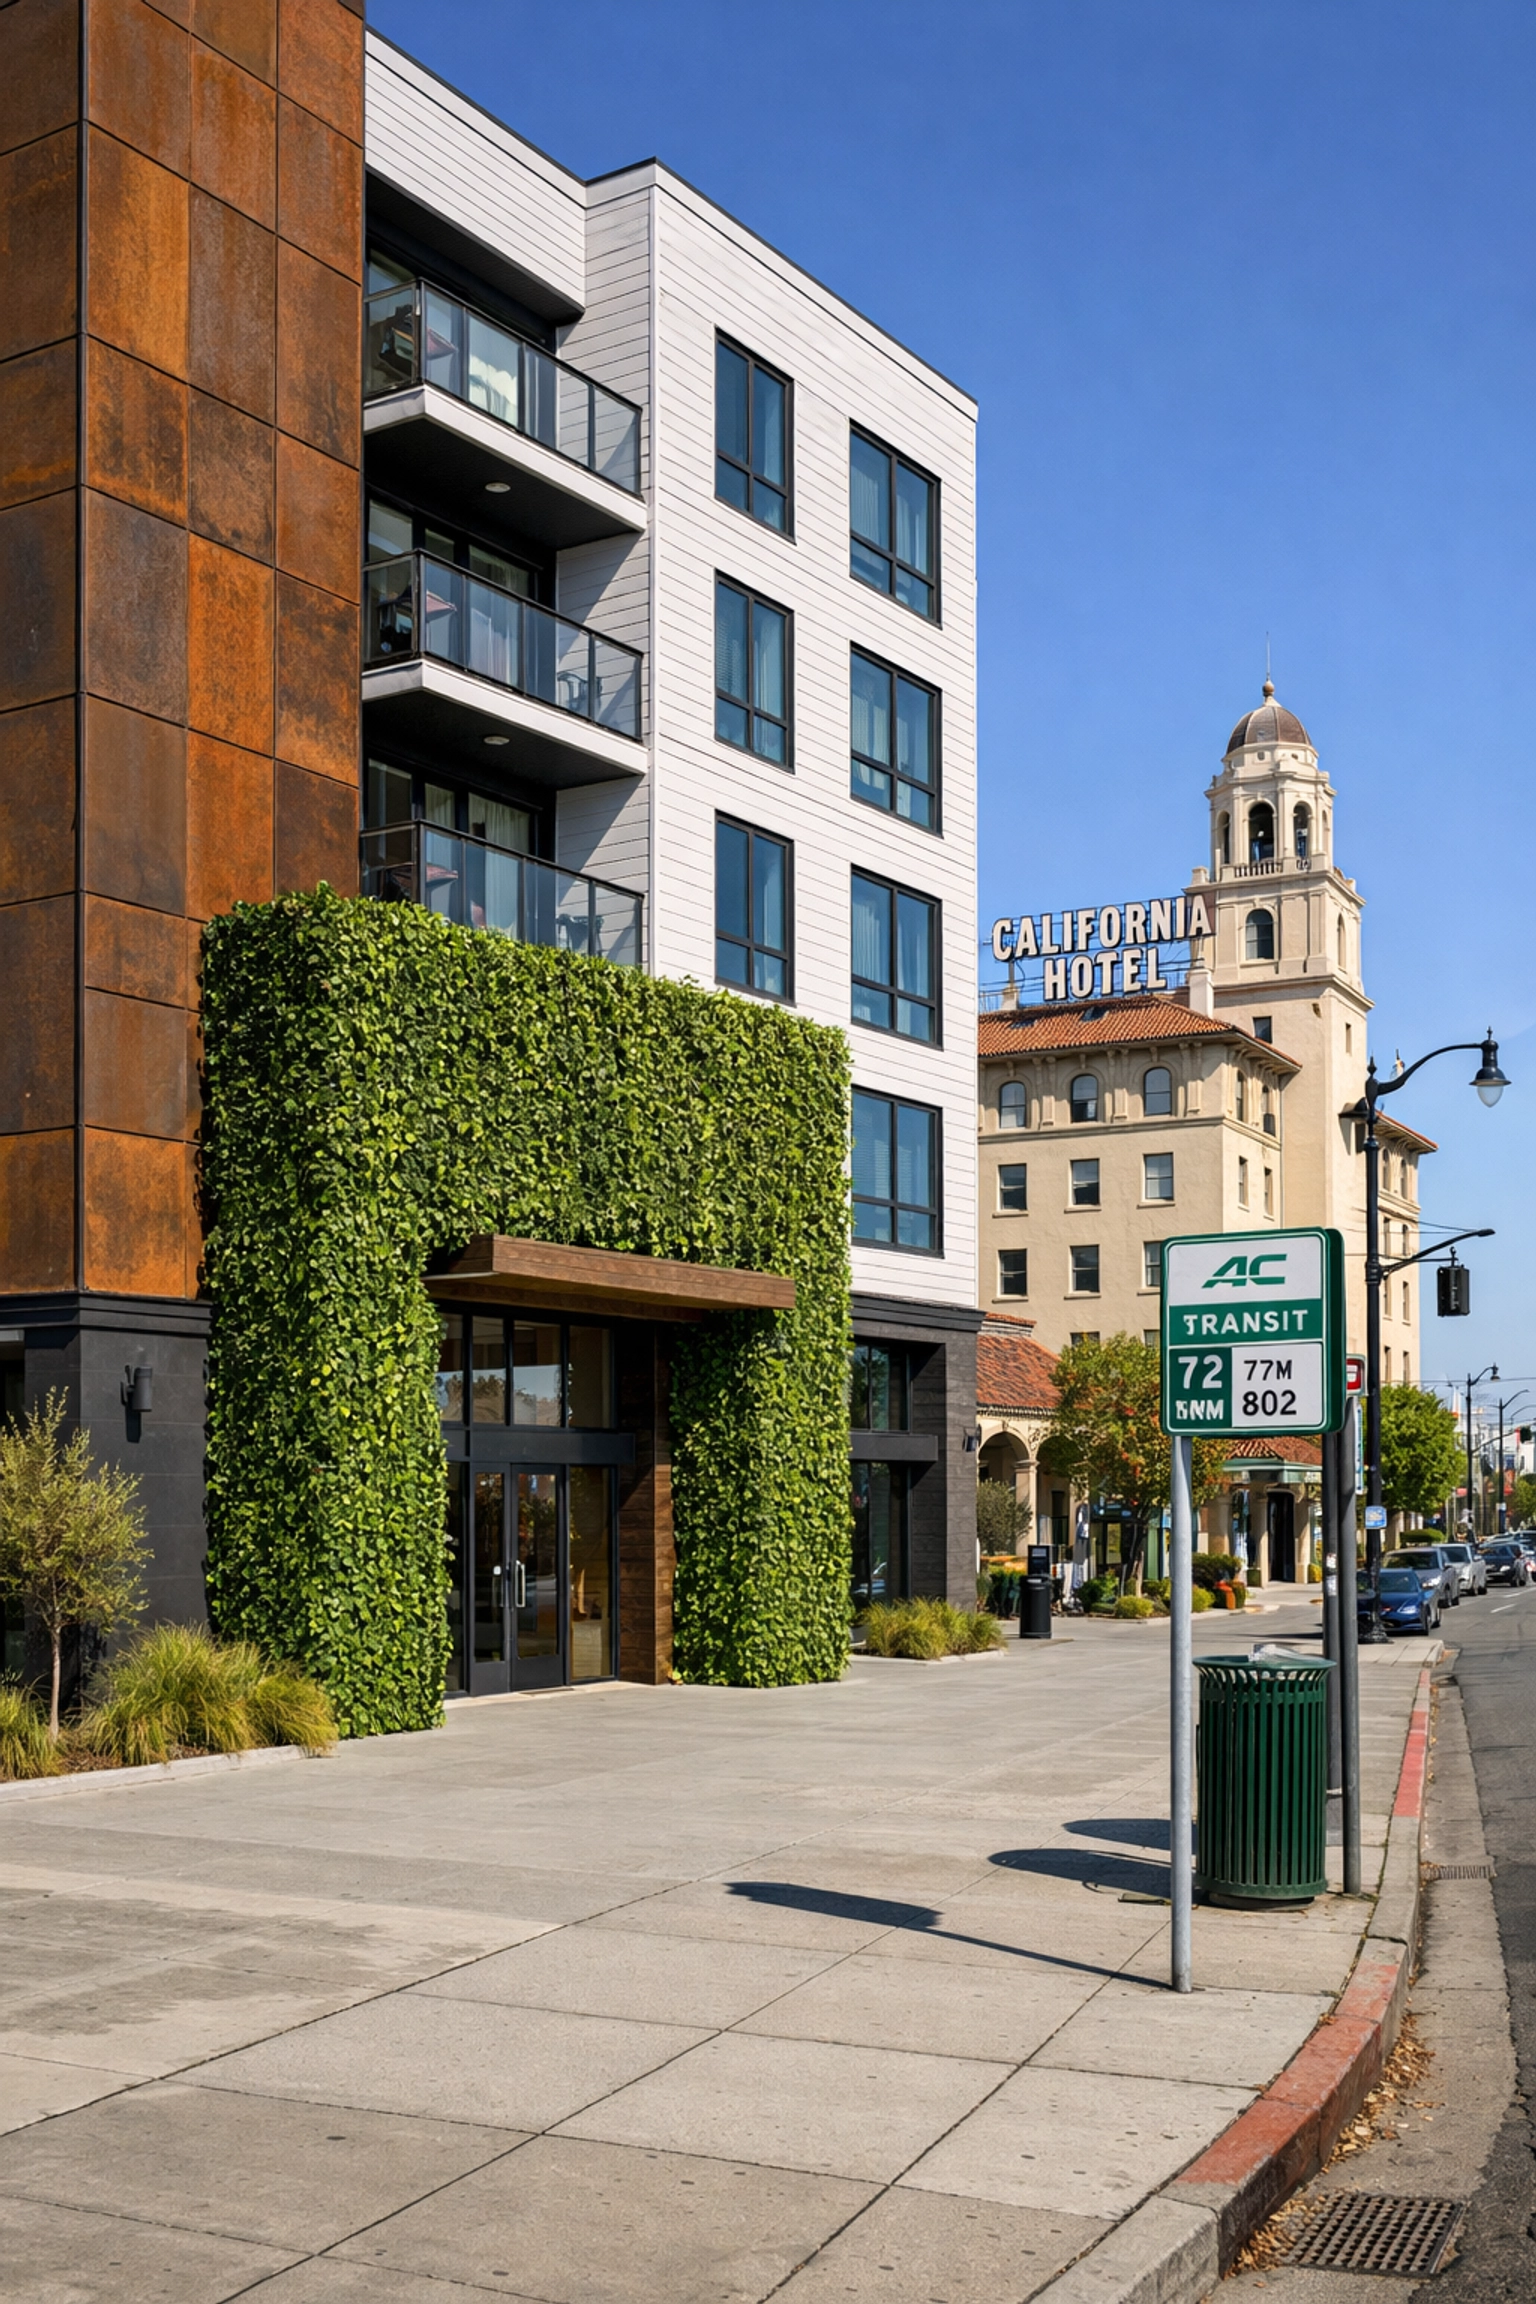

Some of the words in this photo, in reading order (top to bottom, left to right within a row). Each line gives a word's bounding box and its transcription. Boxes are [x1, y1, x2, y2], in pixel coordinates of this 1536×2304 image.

[992, 894, 1216, 962] CALIFORNIA
[1043, 946, 1167, 1001] HOTEL
[1201, 1253, 1288, 1289] AC
[1183, 1309, 1308, 1335] TRANSIT
[1177, 1354, 1223, 1390] 72
[1243, 1359, 1293, 1382] 77M
[1242, 1389, 1297, 1417] 802
